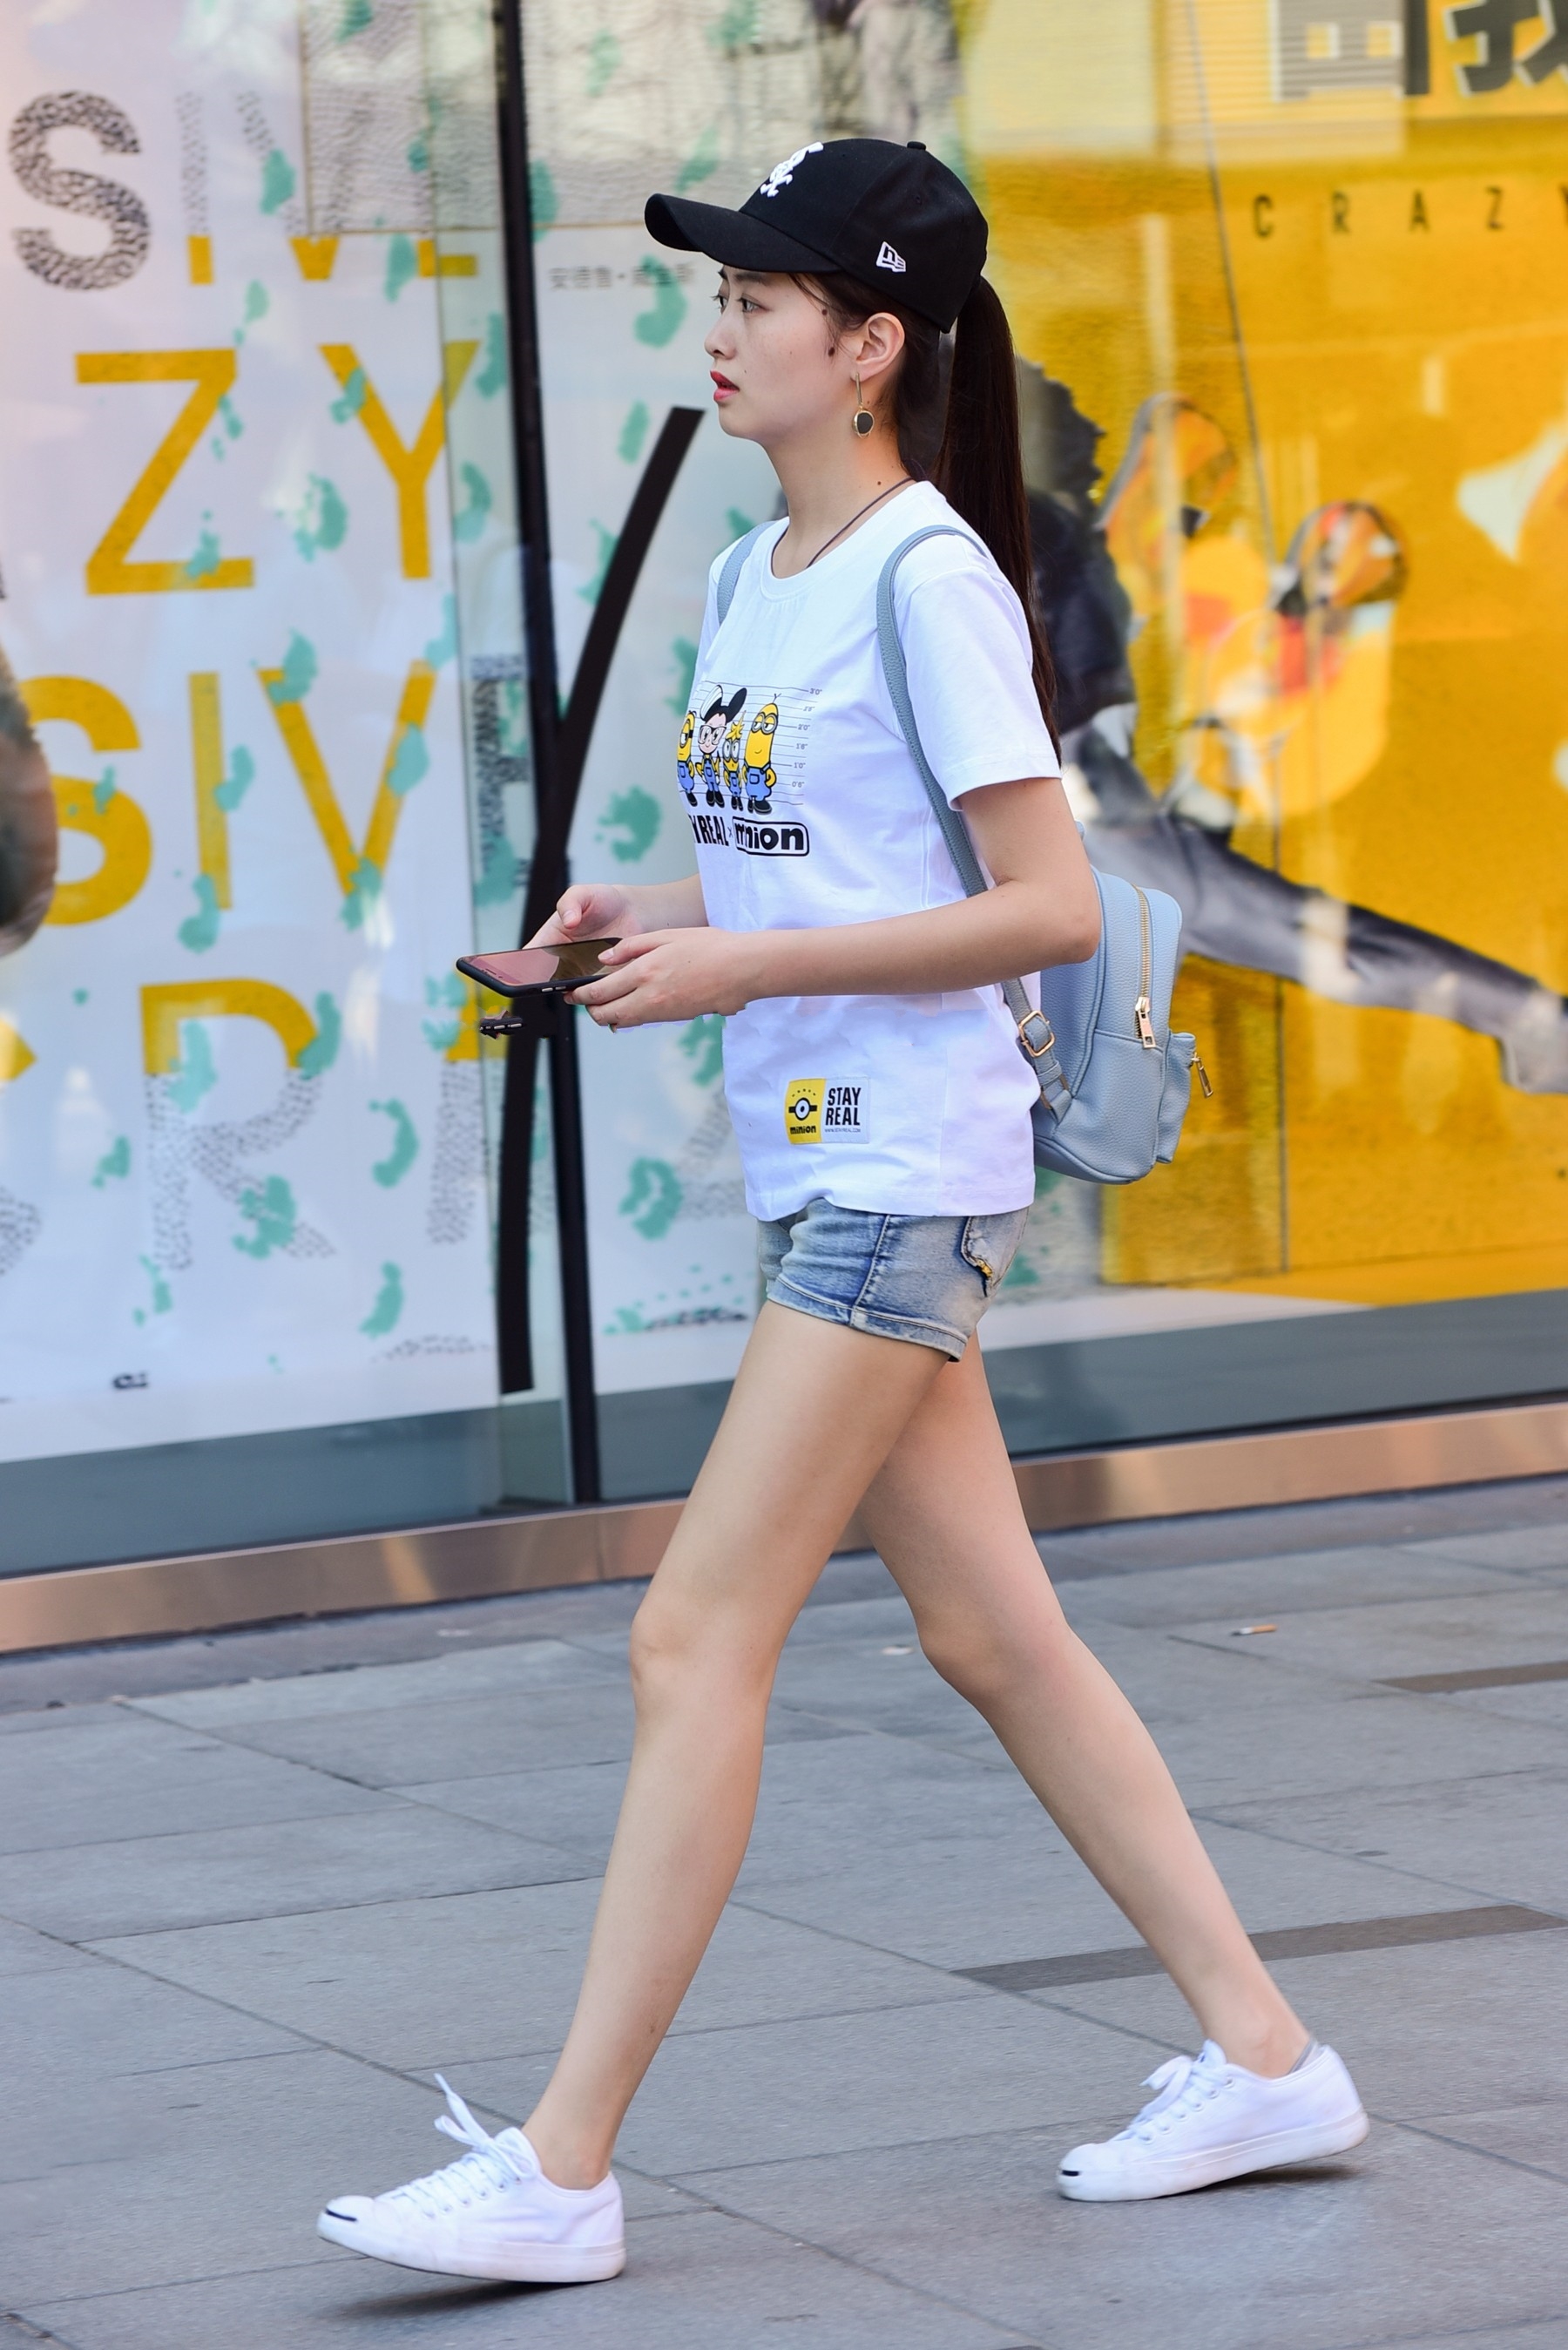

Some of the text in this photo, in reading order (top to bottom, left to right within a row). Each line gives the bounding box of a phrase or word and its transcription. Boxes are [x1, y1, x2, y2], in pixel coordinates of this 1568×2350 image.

[734, 823, 804, 850] mnion
[828, 1087, 862, 1106] STAY
[825, 1107, 861, 1126] REAL
[789, 1125, 816, 1134] minion
